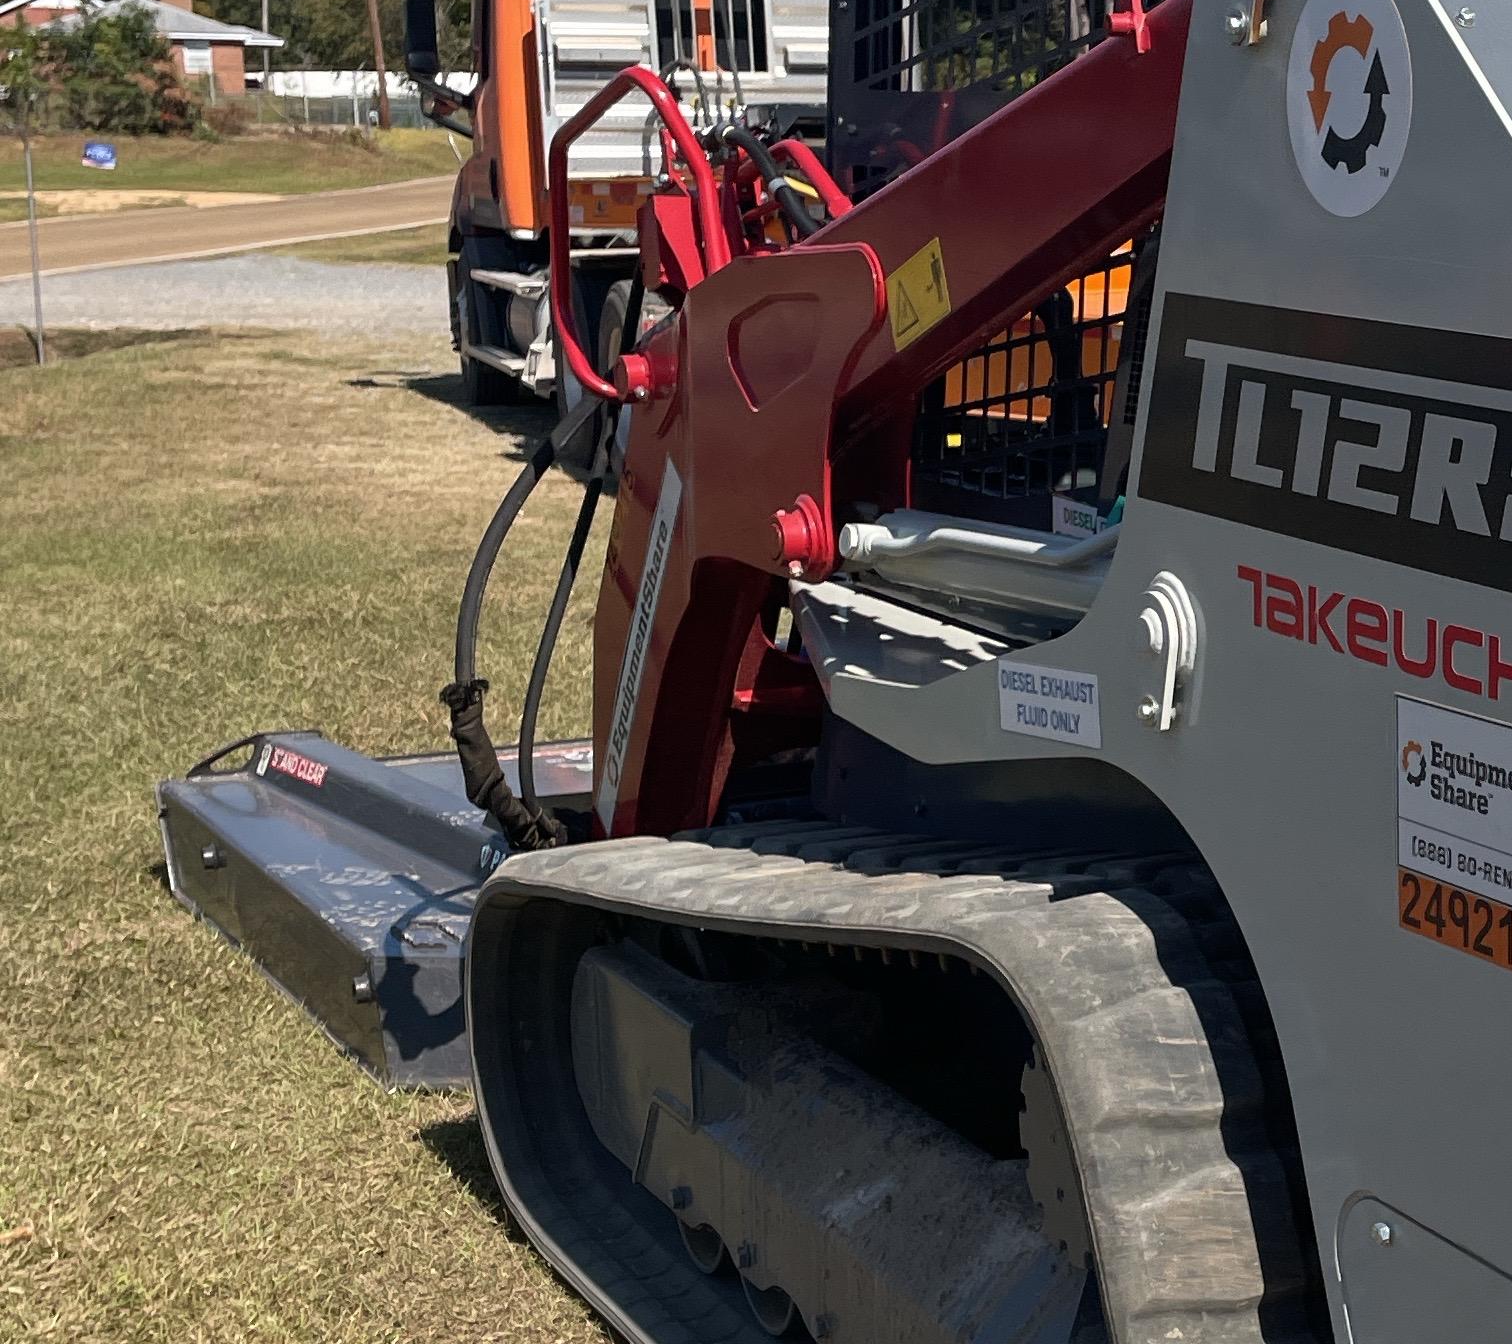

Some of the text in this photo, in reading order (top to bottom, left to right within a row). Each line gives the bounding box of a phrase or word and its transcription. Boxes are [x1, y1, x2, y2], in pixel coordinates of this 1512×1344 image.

[613, 519, 668, 759] EquipmentShare
[1000, 669, 1095, 705] DIESEL EXHAUST
[1016, 703, 1080, 735] FLUID ONLY
[297, 757, 326, 785] CLEAR
[1430, 774, 1490, 815] Share
[1412, 836, 1452, 870] (888)
